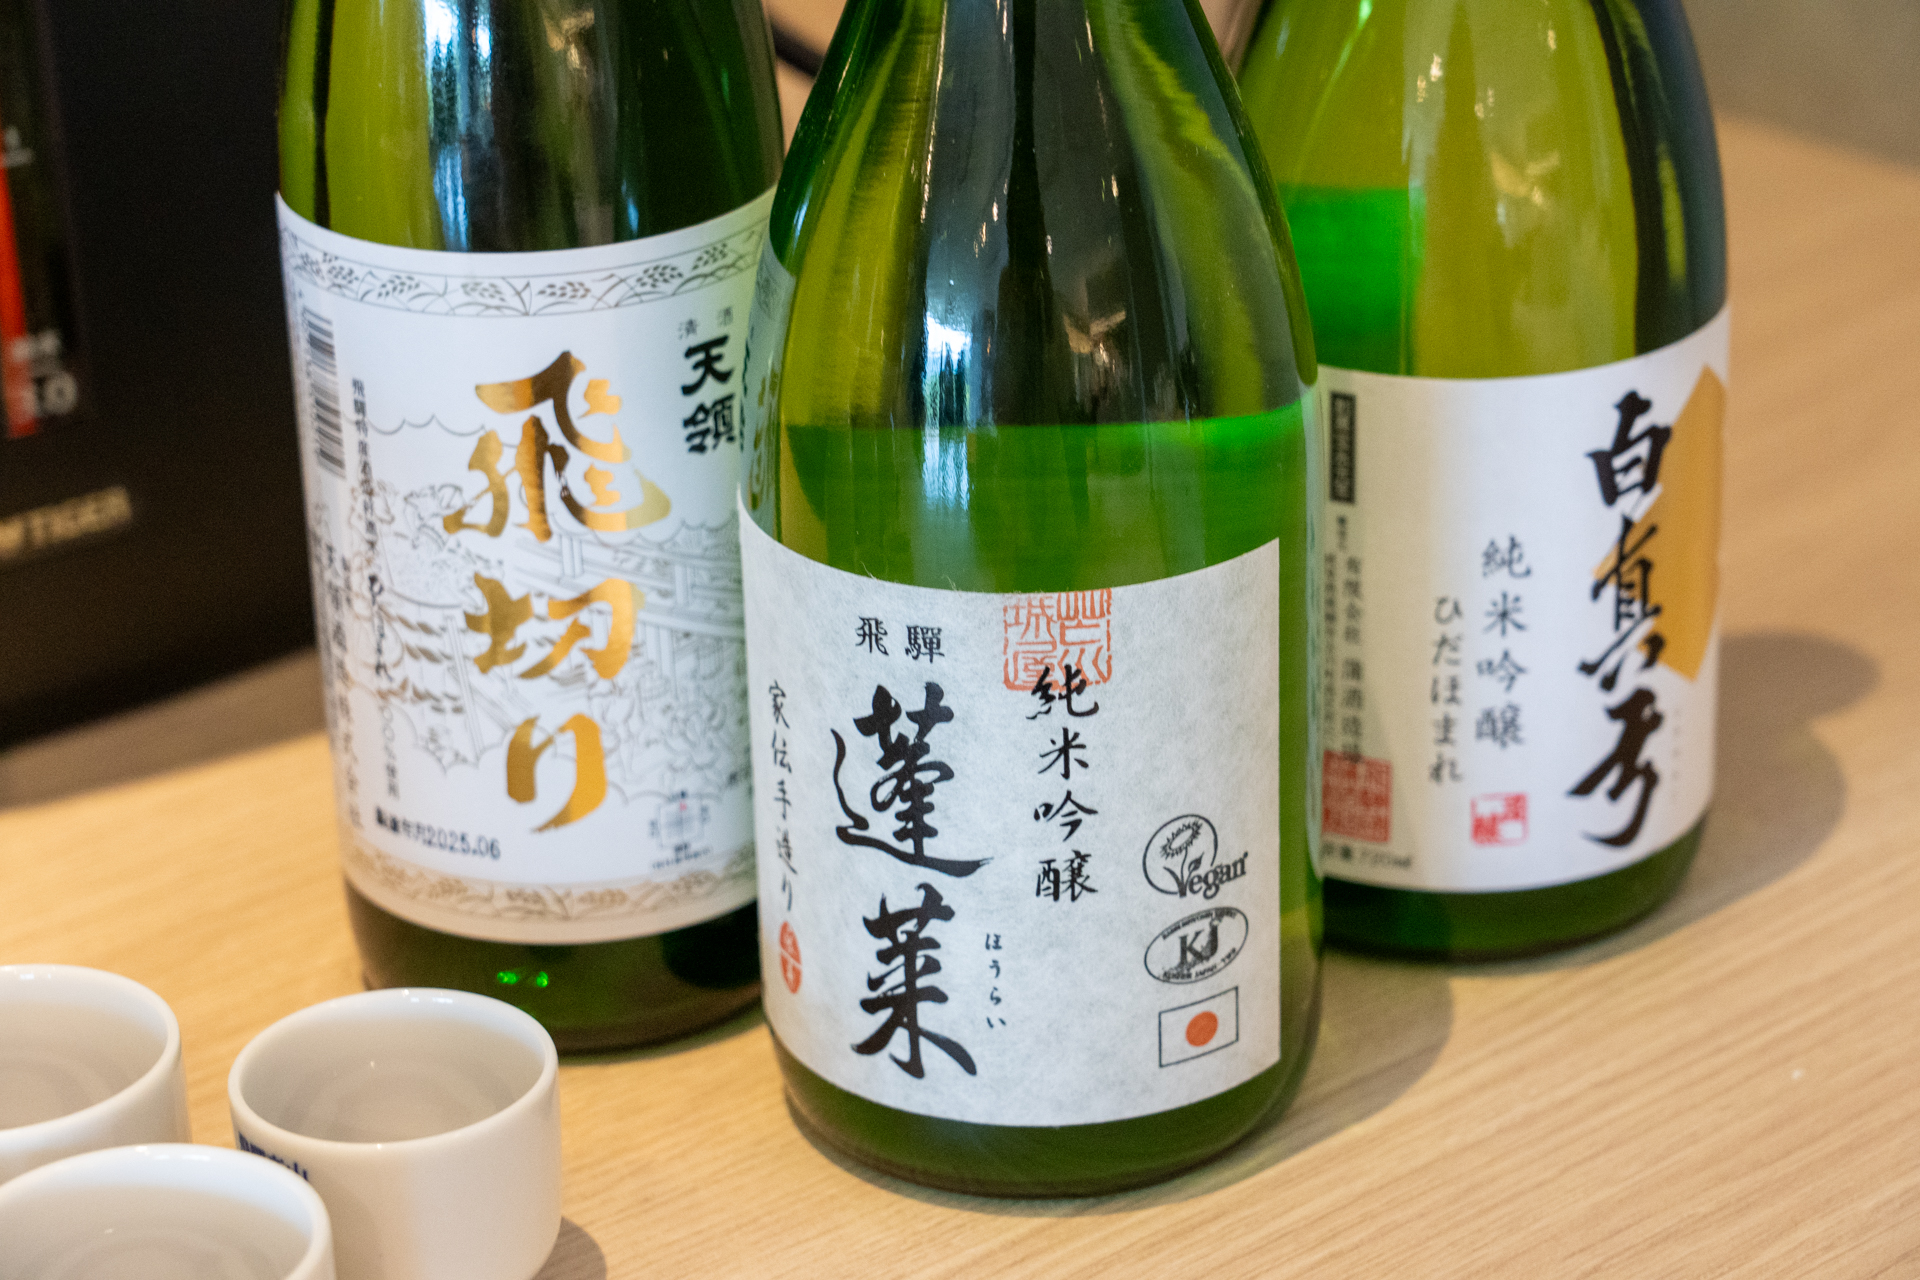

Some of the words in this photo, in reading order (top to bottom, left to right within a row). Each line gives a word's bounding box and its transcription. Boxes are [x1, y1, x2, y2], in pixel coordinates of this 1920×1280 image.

[681, 334, 736, 454] 天領
[442, 350, 672, 834] 飛切り
[1429, 596, 1463, 787] ひだほまれ
[1475, 534, 1532, 750] 純米吟醸
[830, 680, 995, 1080] 蓬莱
[1026, 664, 1099, 902] 純米吟醸
[1162, 851, 1249, 900] Vegan
[985, 932, 1007, 1029] ほうらい
